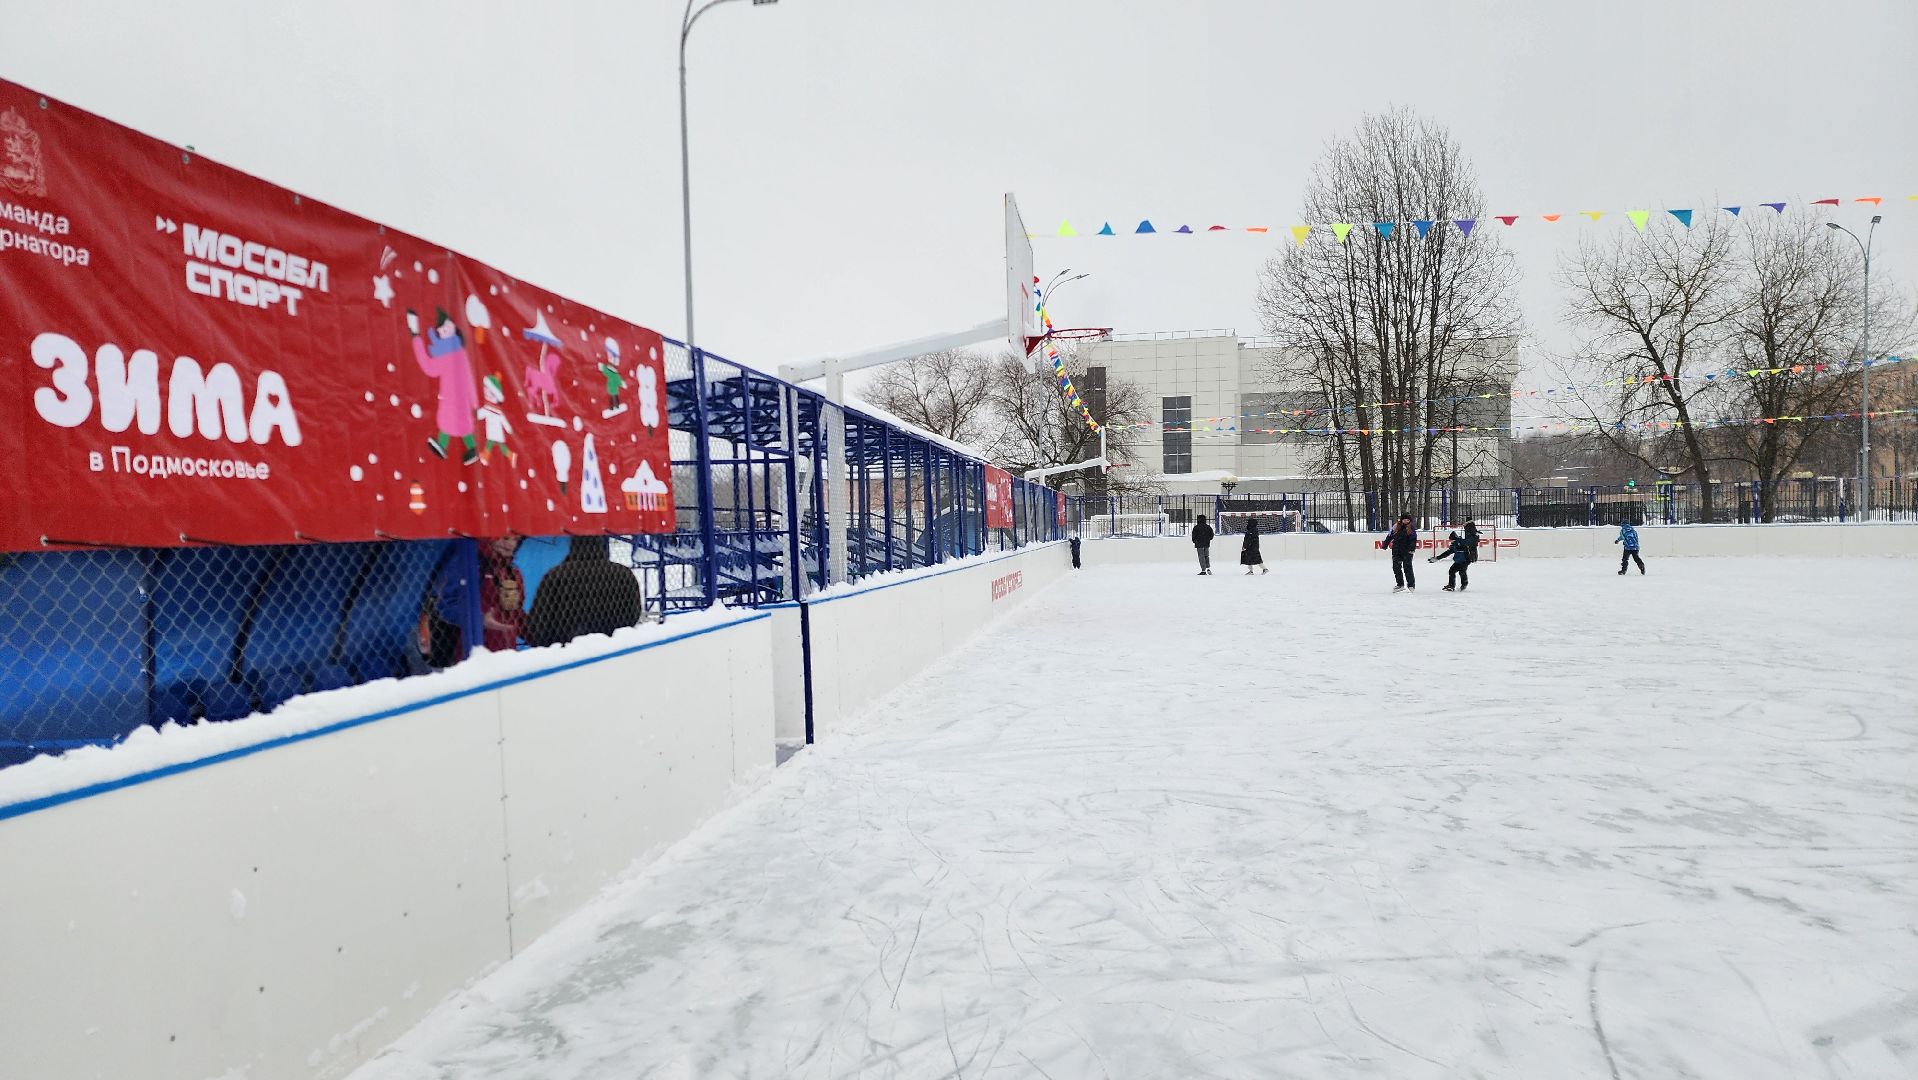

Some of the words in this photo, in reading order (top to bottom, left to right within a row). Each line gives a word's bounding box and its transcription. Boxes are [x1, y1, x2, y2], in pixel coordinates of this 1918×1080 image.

[182, 222, 329, 293] МОСОБЛ
[186, 260, 302, 316] СПОРТ
[31, 332, 302, 447] ЗИМА
[90, 451, 104, 472] в
[111, 446, 270, 480] Подмосковье
